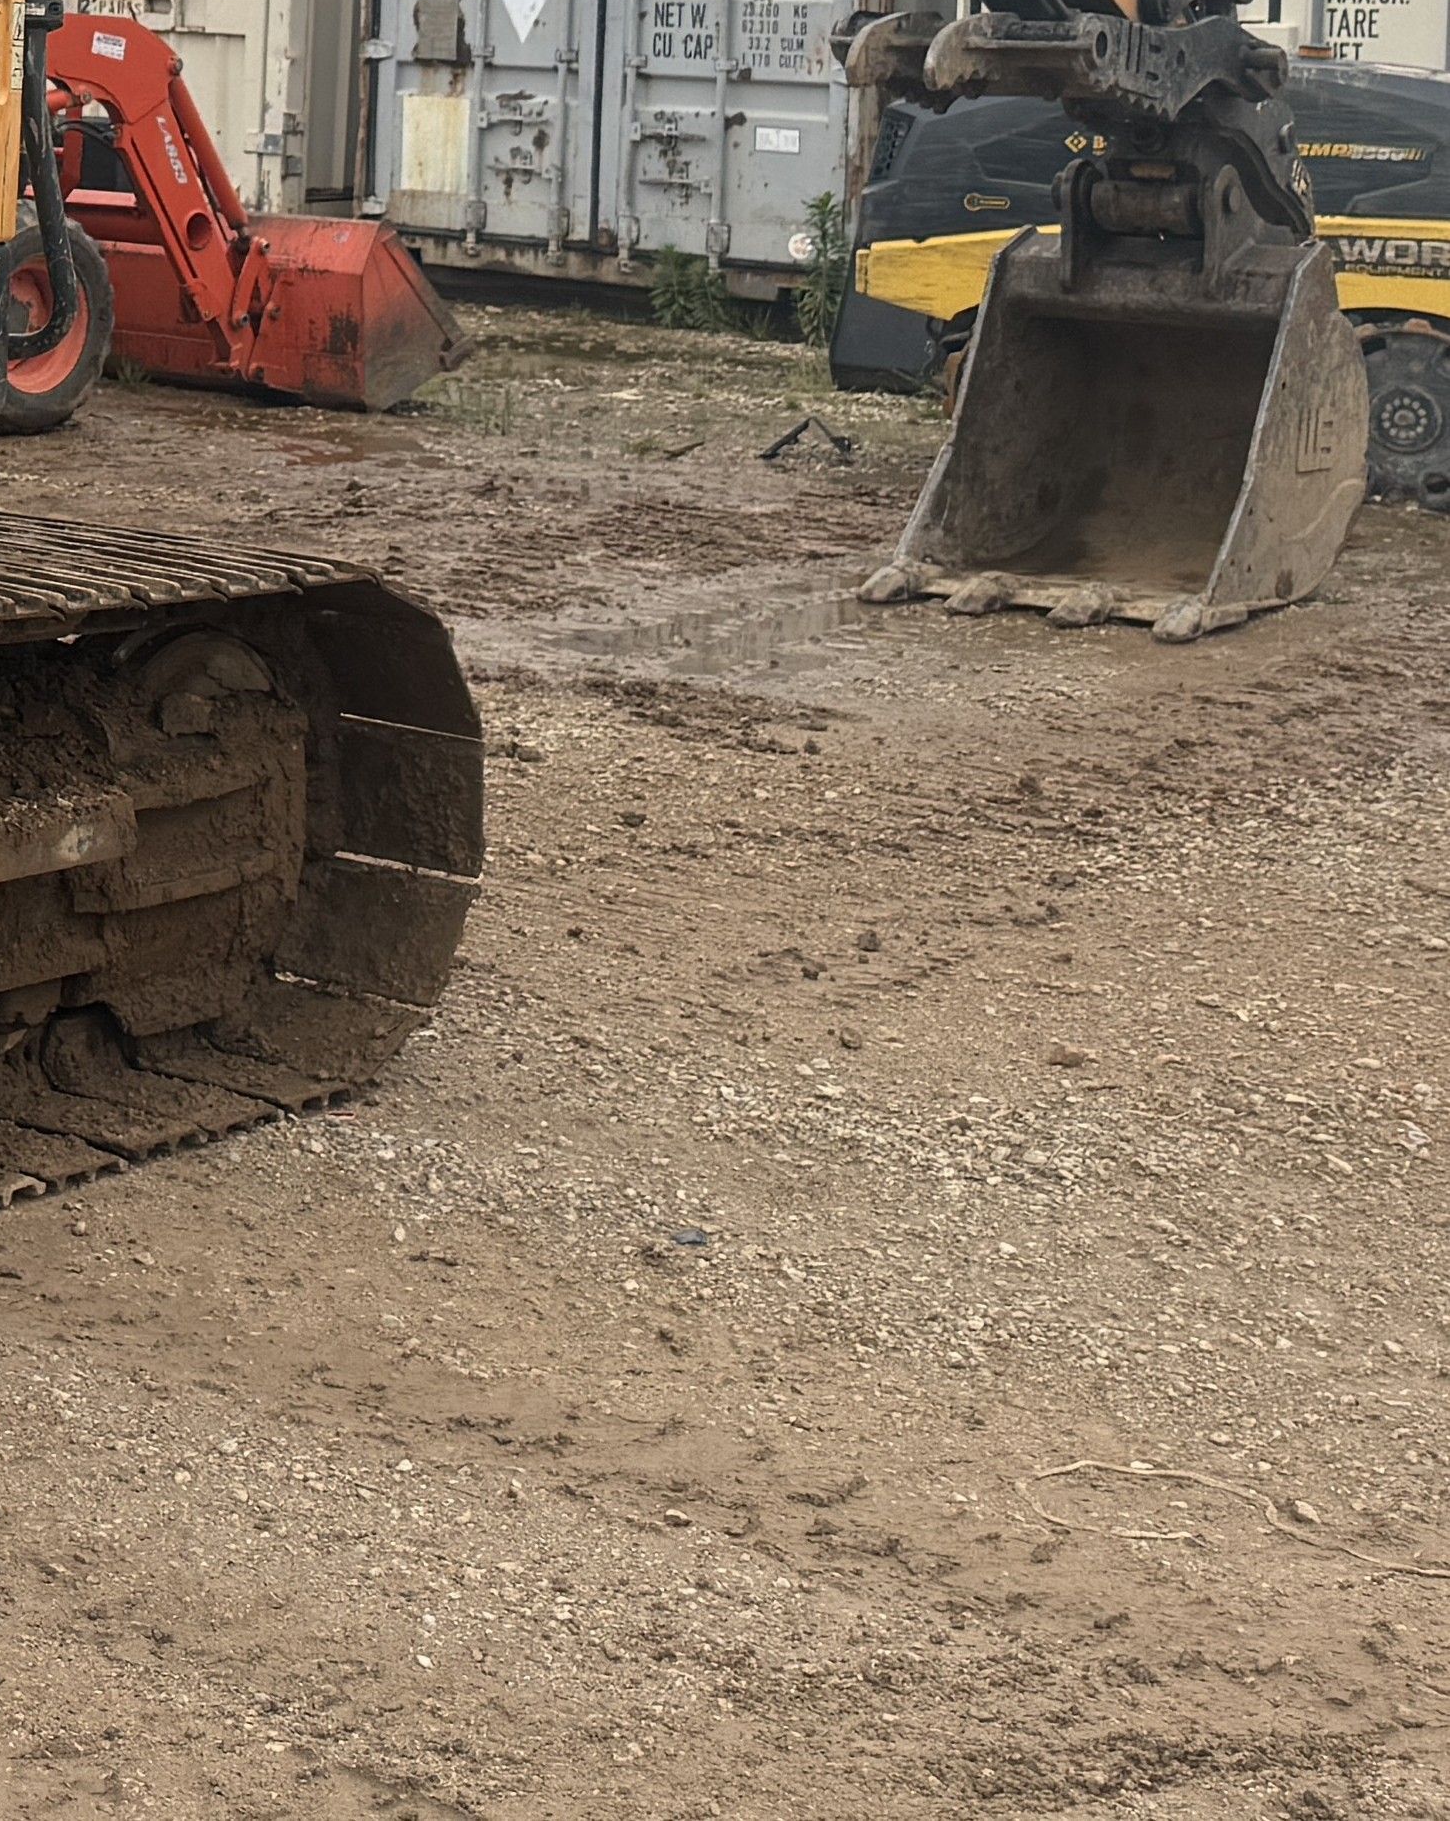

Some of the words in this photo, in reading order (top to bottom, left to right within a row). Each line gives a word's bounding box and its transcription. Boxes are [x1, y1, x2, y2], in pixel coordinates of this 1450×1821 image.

[654, 2, 685, 28] NET
[690, 2, 709, 30] W.
[793, 5, 808, 20] KG
[1326, 8, 1380, 38] TARE
[793, 21, 808, 36] LB
